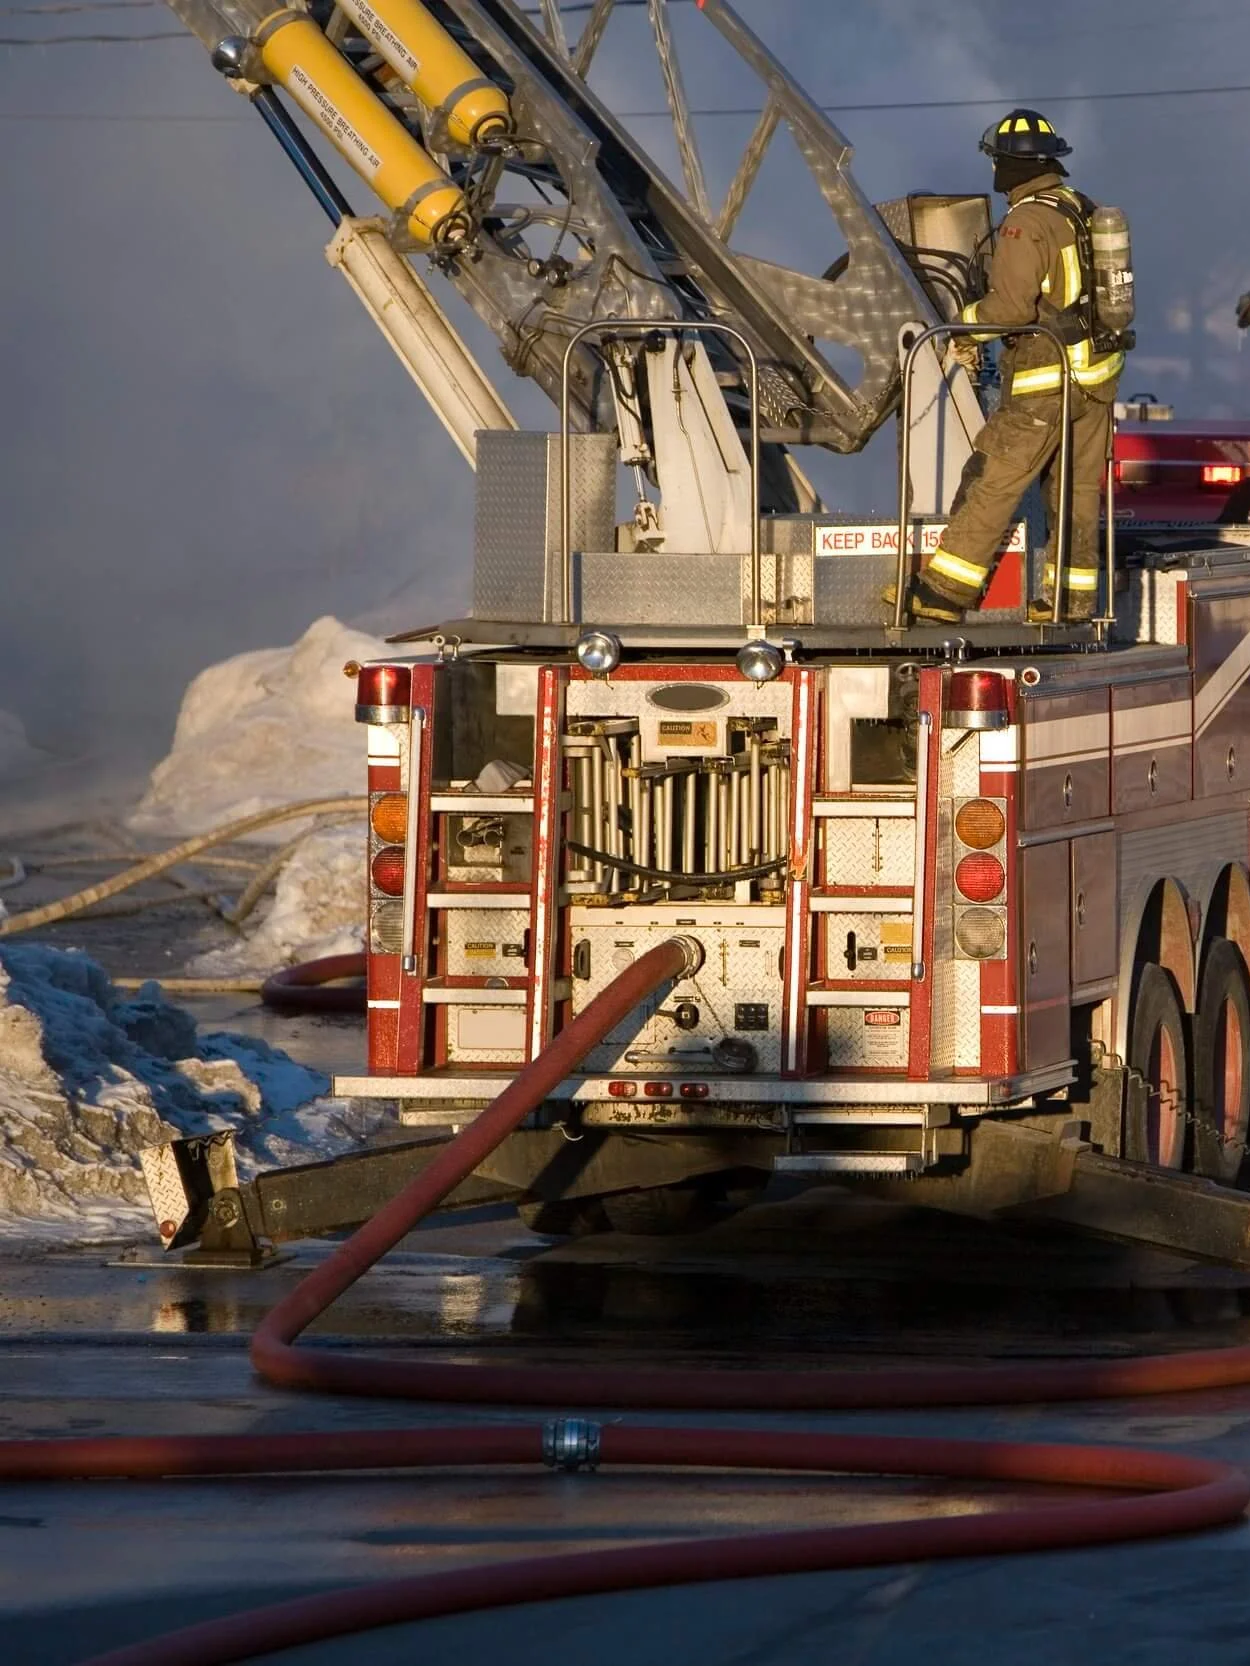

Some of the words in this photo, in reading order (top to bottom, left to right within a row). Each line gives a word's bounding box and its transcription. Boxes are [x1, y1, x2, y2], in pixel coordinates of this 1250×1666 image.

[374, 20, 407, 58] BREATHING
[406, 56, 418, 70] AIR
[292, 67, 308, 86] HIGH
[307, 83, 338, 120] PRESSURE
[336, 116, 370, 156] BREATHING
[368, 154, 380, 169] AIR
[822, 532, 865, 550] KEEP
[870, 1013, 896, 1023] DANGER
